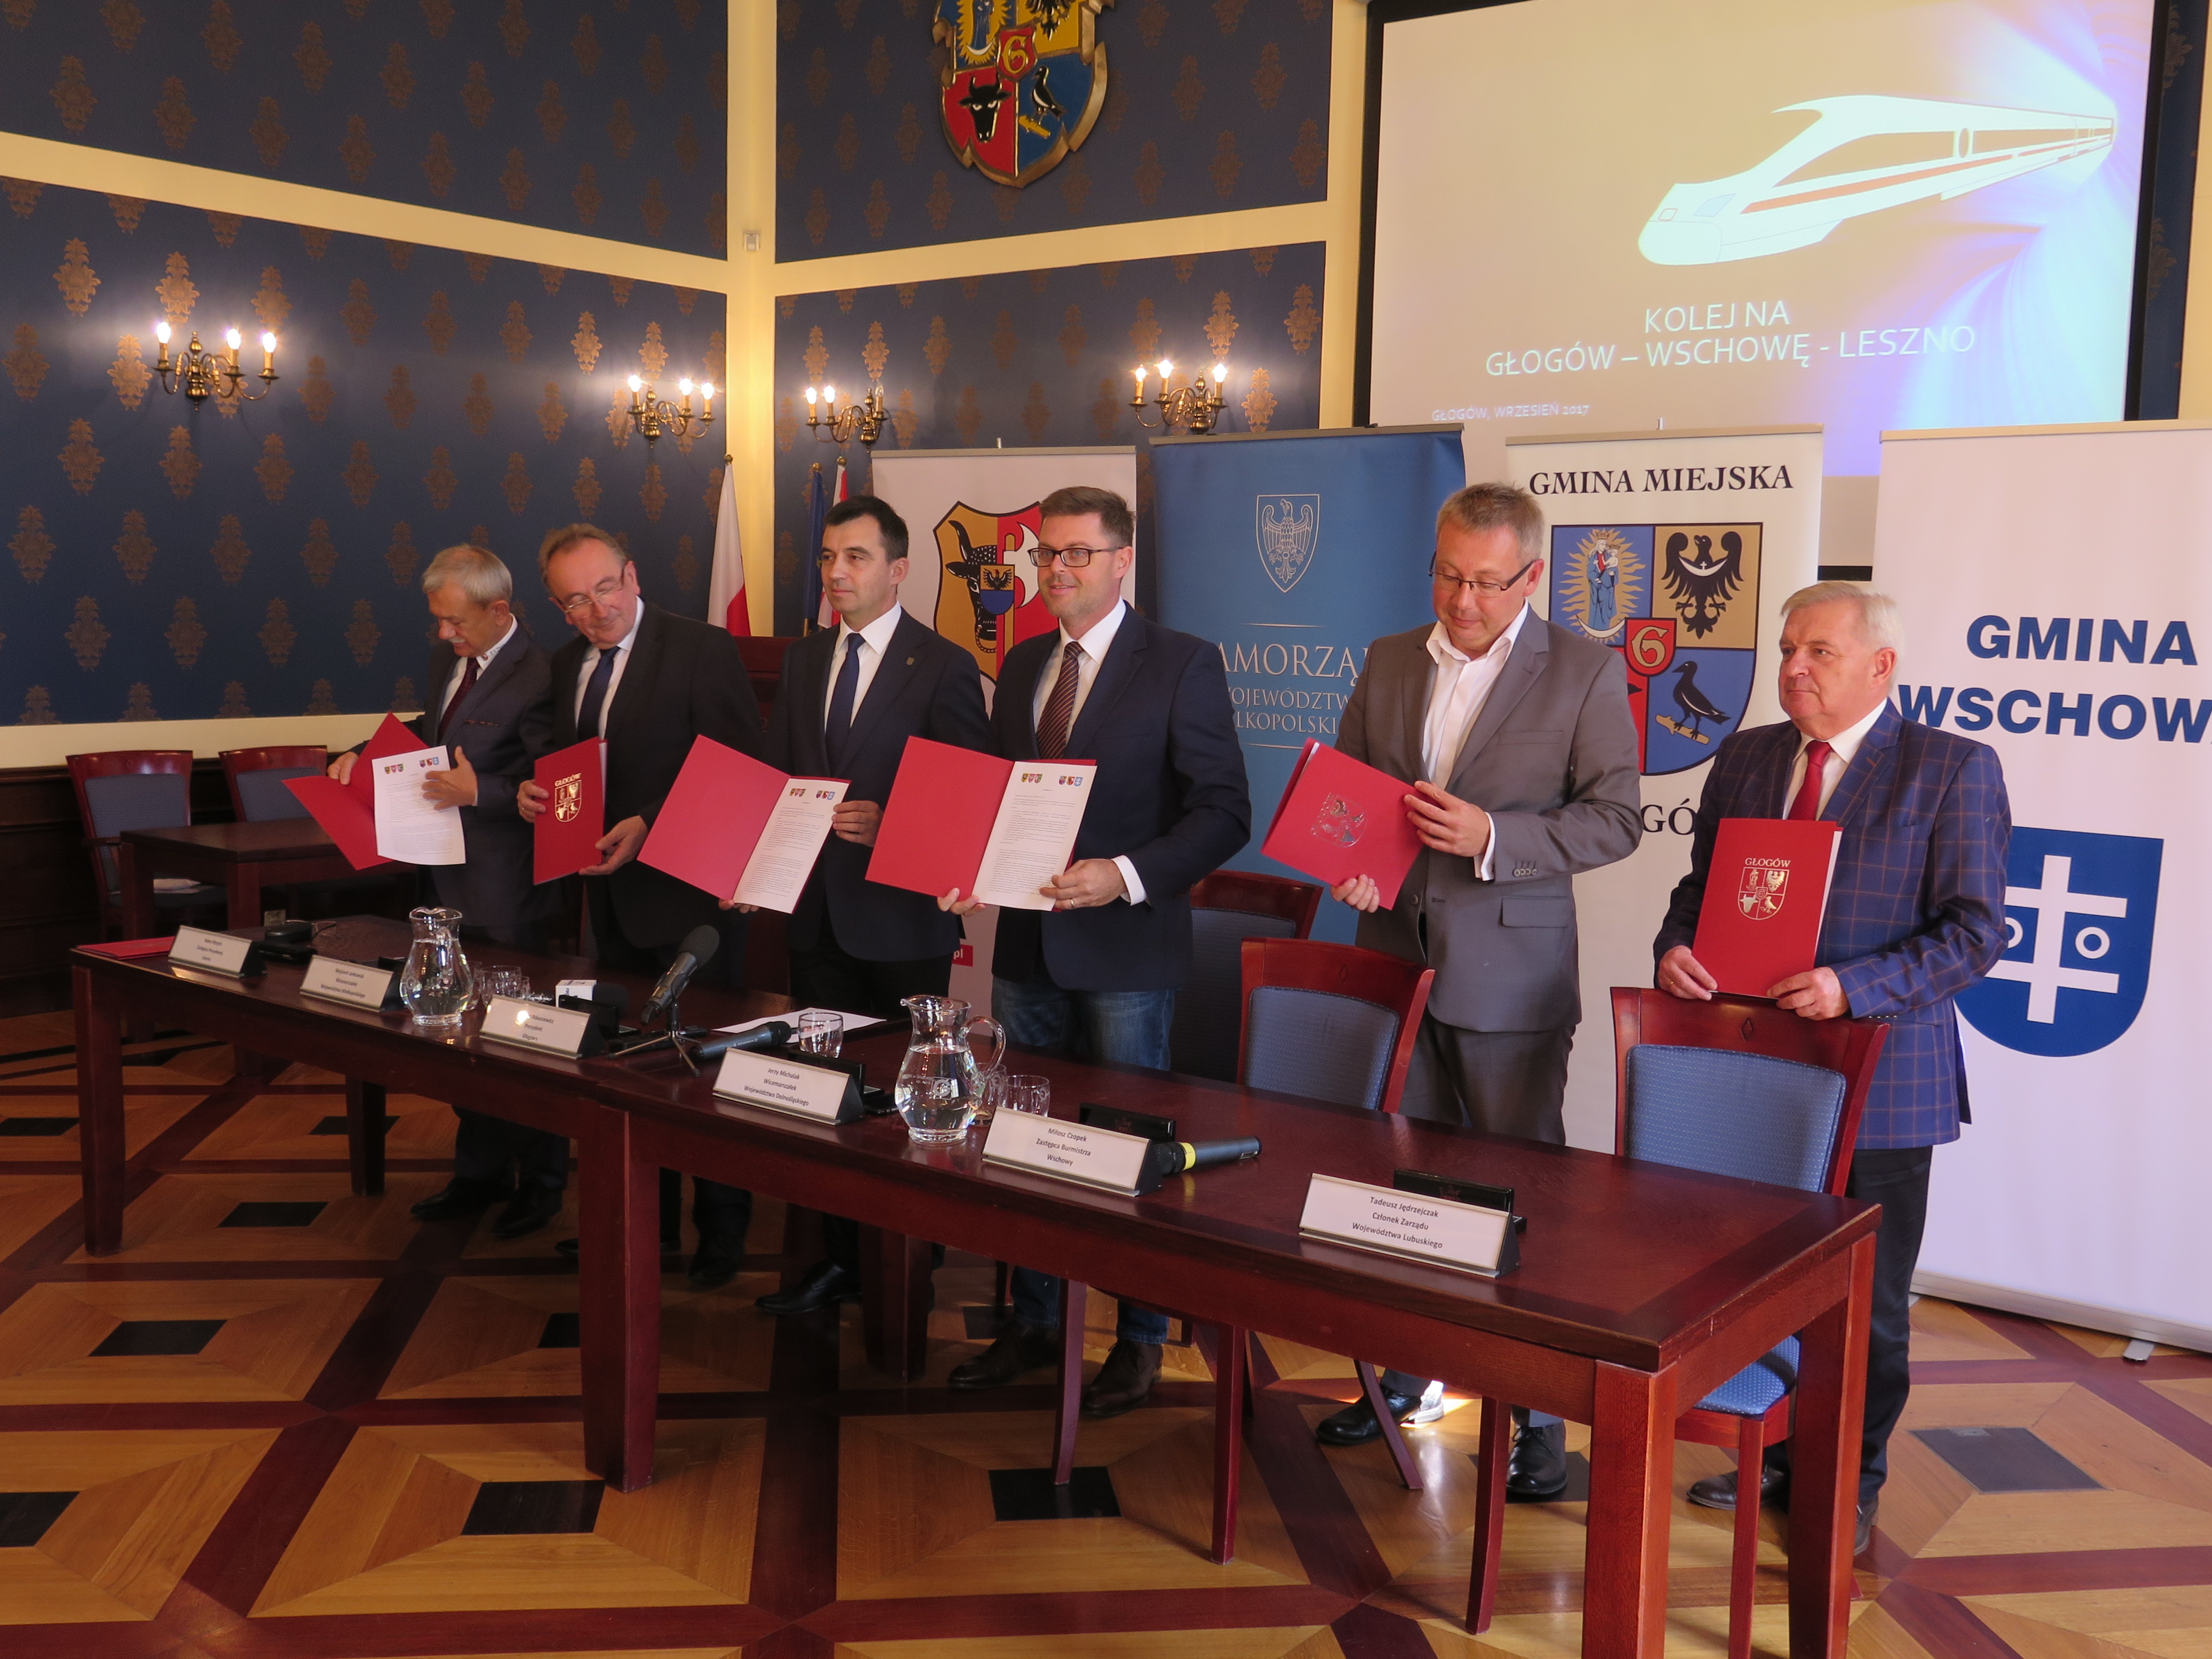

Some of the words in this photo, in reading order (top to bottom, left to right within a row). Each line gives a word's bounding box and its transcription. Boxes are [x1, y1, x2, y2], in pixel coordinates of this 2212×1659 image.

[1645, 302, 1736, 333] KOLEJ
[1745, 300, 1790, 327] NA
[1486, 341, 1615, 376] GŁOGÓW
[1645, 333, 1810, 367] WSCHOWĘ
[1839, 325, 1975, 358] LESZNO
[1432, 406, 1490, 421] GŁOGÓW,
[1494, 401, 1558, 418] WRZESIEŃ
[1562, 405, 1590, 416] 2017
[1529, 470, 1635, 495] GMINA
[1642, 465, 1794, 493] MIEJSKA
[1966, 614, 2198, 666] GMINA
[1218, 641, 1367, 687] AMORZĄ
[1229, 687, 1351, 710] OJEWÓDZTW
[1233, 712, 1337, 734] LKOPOLSKI
[1898, 685, 2212, 744] WSCHOW
[1640, 798, 1695, 835] GÓ
[1745, 858, 1791, 867] GŁOGÓW
[953, 948, 963, 959] pl
[764, 1079, 796, 1090] Wicemarszałek
[780, 1071, 800, 1079] Michalak
[744, 1085, 775, 1097] Województwa
[776, 1093, 809, 1106] Dolnośląskiego
[1048, 1128, 1066, 1137] Miłosz
[1067, 1133, 1087, 1142] Czopek
[1036, 1138, 1060, 1149] Zastępca
[1061, 1144, 1091, 1156] Burmistrza
[1047, 1154, 1074, 1167] Wschowy
[1370, 1197, 1398, 1209] Tadeusz
[1399, 1203, 1439, 1218] Jędrzejczak
[1372, 1212, 1399, 1224] Członek
[1400, 1218, 1429, 1230] Zarządu
[1352, 1222, 1401, 1239] Województwa
[1403, 1234, 1443, 1249] Lubuskiego
